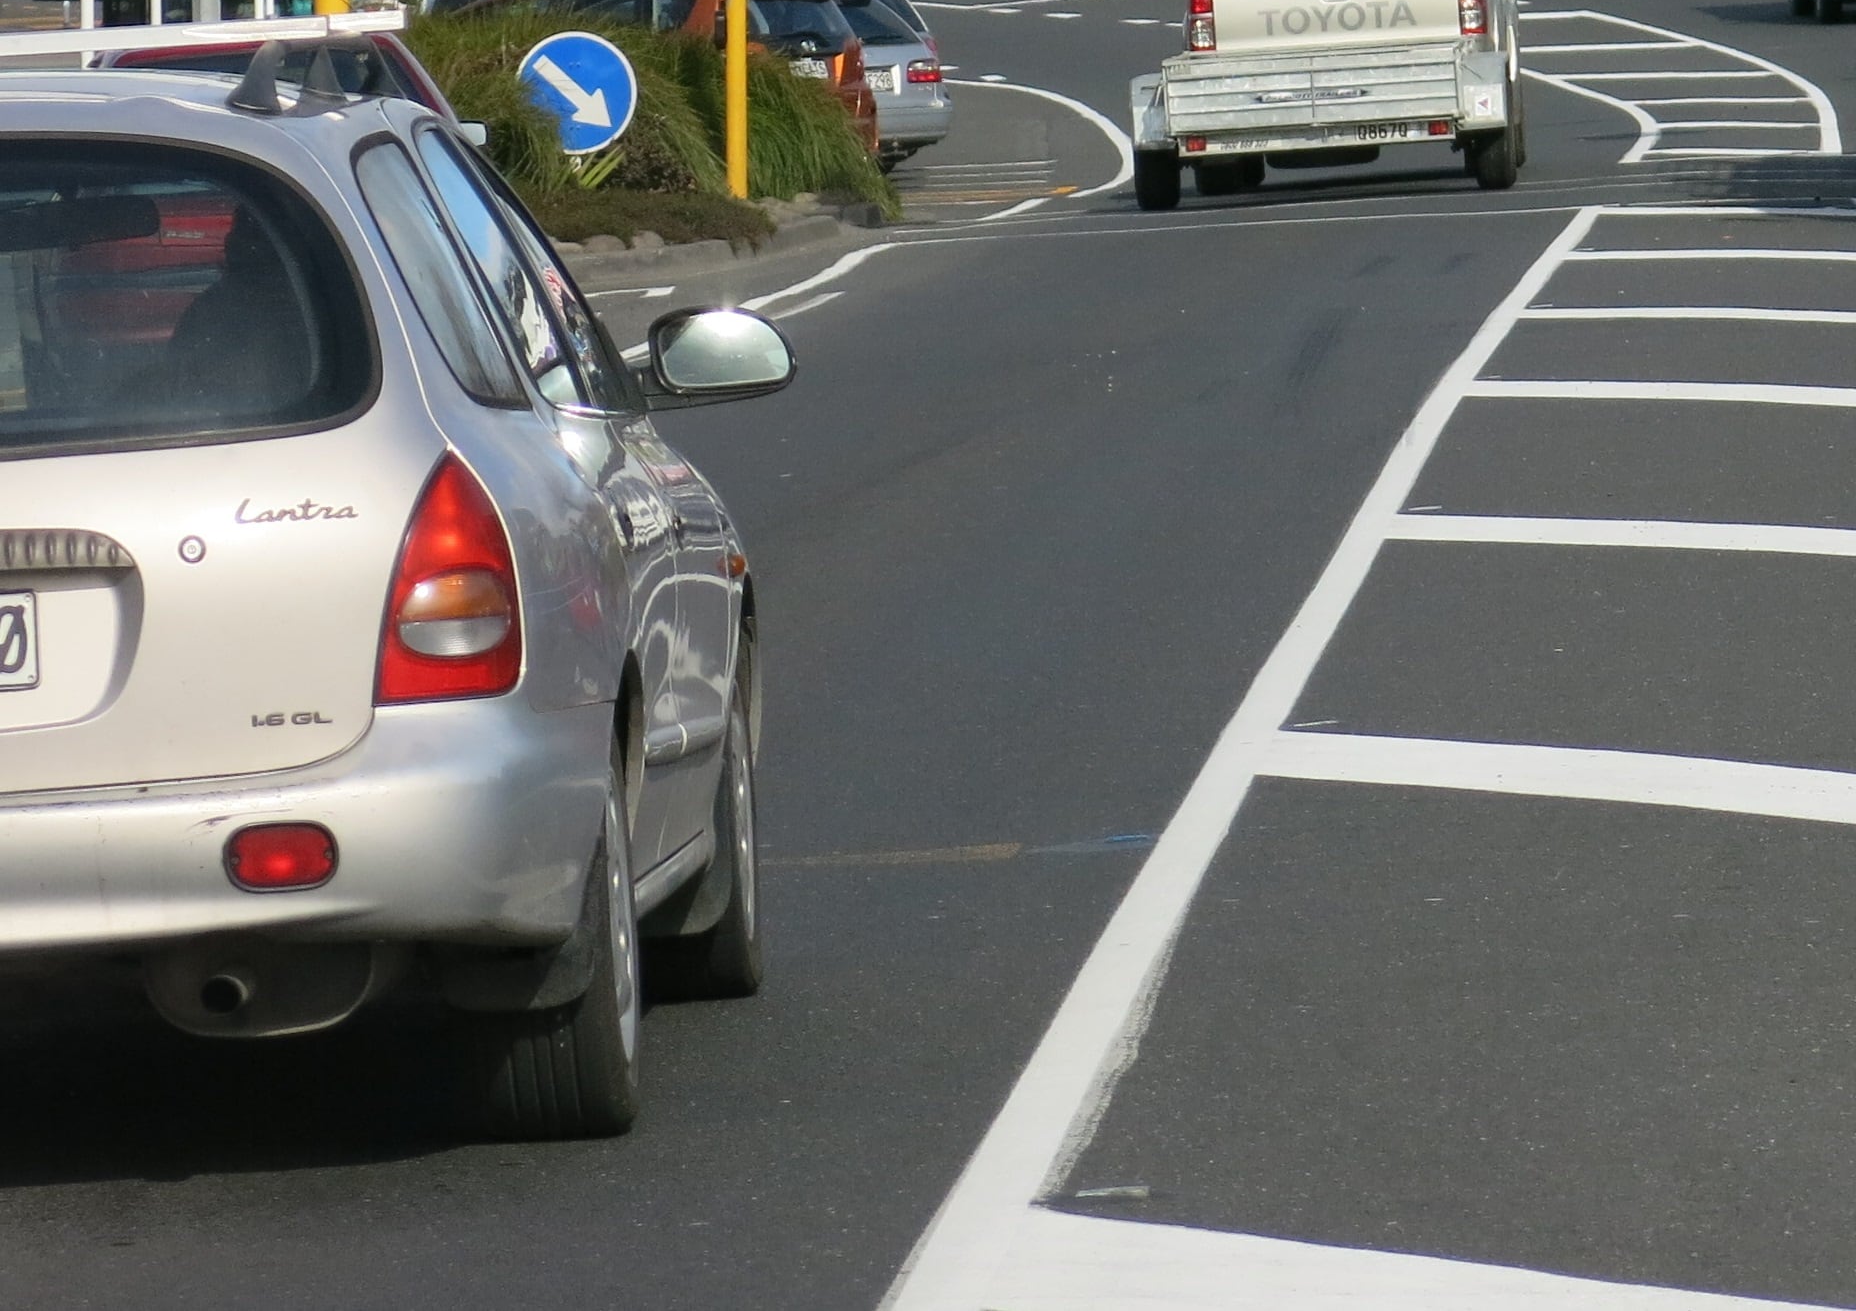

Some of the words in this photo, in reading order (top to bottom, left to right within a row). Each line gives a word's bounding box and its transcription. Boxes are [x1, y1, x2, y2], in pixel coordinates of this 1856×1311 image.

[1257, 0, 1418, 36] TOYOTA
[235, 498, 359, 524] Lantra
[251, 714, 286, 727] 1.6
[291, 712, 333, 725] GL
